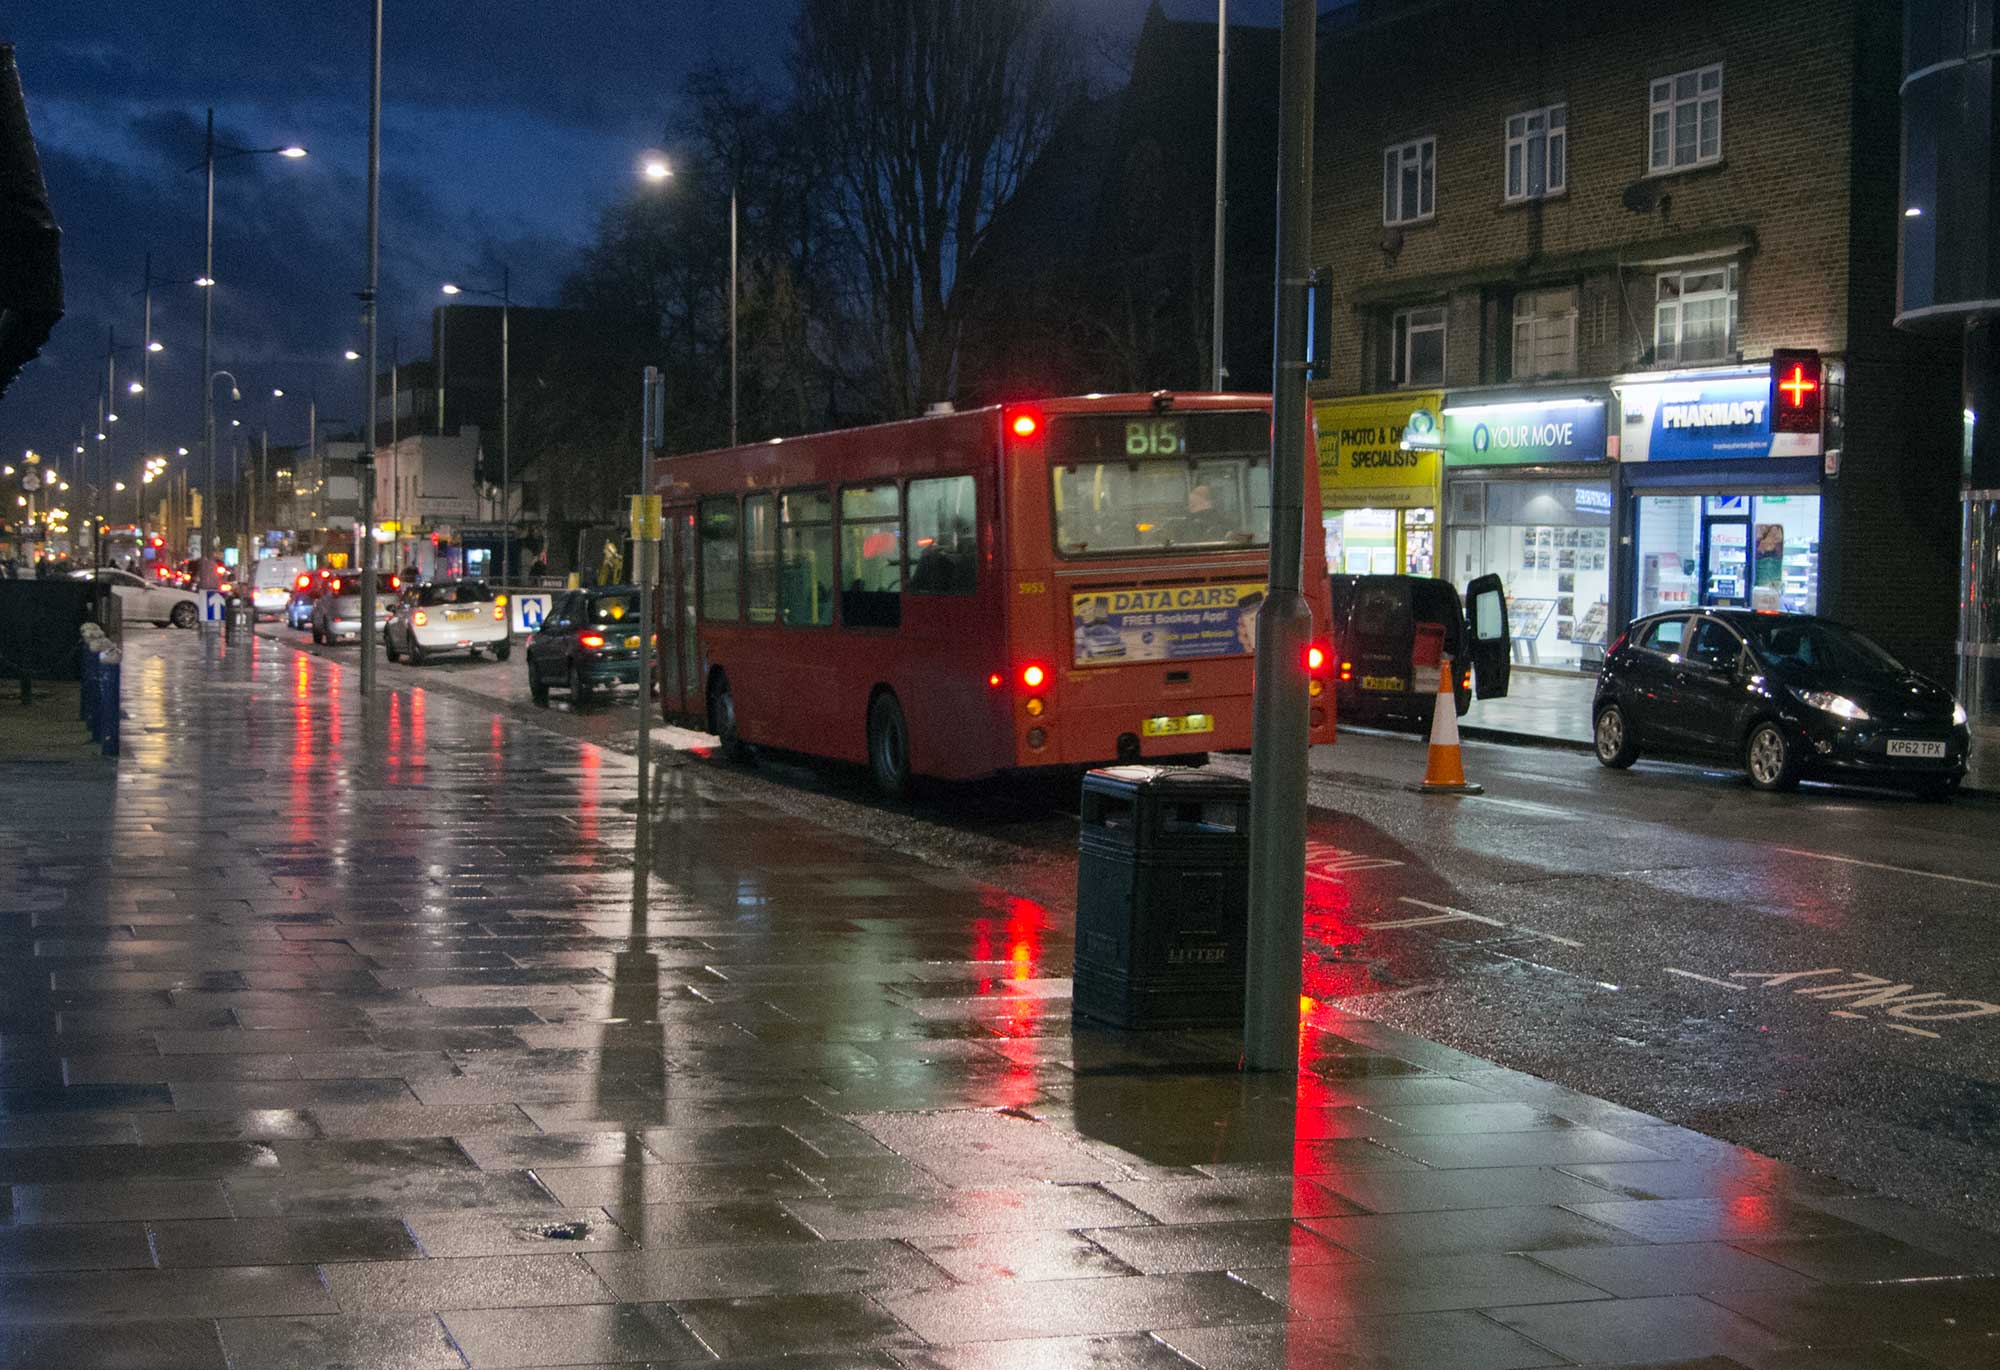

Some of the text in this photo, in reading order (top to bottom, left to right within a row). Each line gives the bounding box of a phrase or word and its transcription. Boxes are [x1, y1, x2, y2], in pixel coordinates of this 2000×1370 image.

[1662, 400, 1766, 429] PHARMACY
[1125, 423, 1178, 455] B15
[1341, 428, 1376, 446] PHOTO
[1378, 427, 1386, 444] &
[1491, 423, 1573, 449] YOUR MOVE
[1352, 450, 1418, 469] SPECIALISTS
[1115, 587, 1237, 611] DATA CARS
[1122, 609, 1229, 626] FREE Booking App!
[1891, 741, 1941, 754] KP62 TPX
